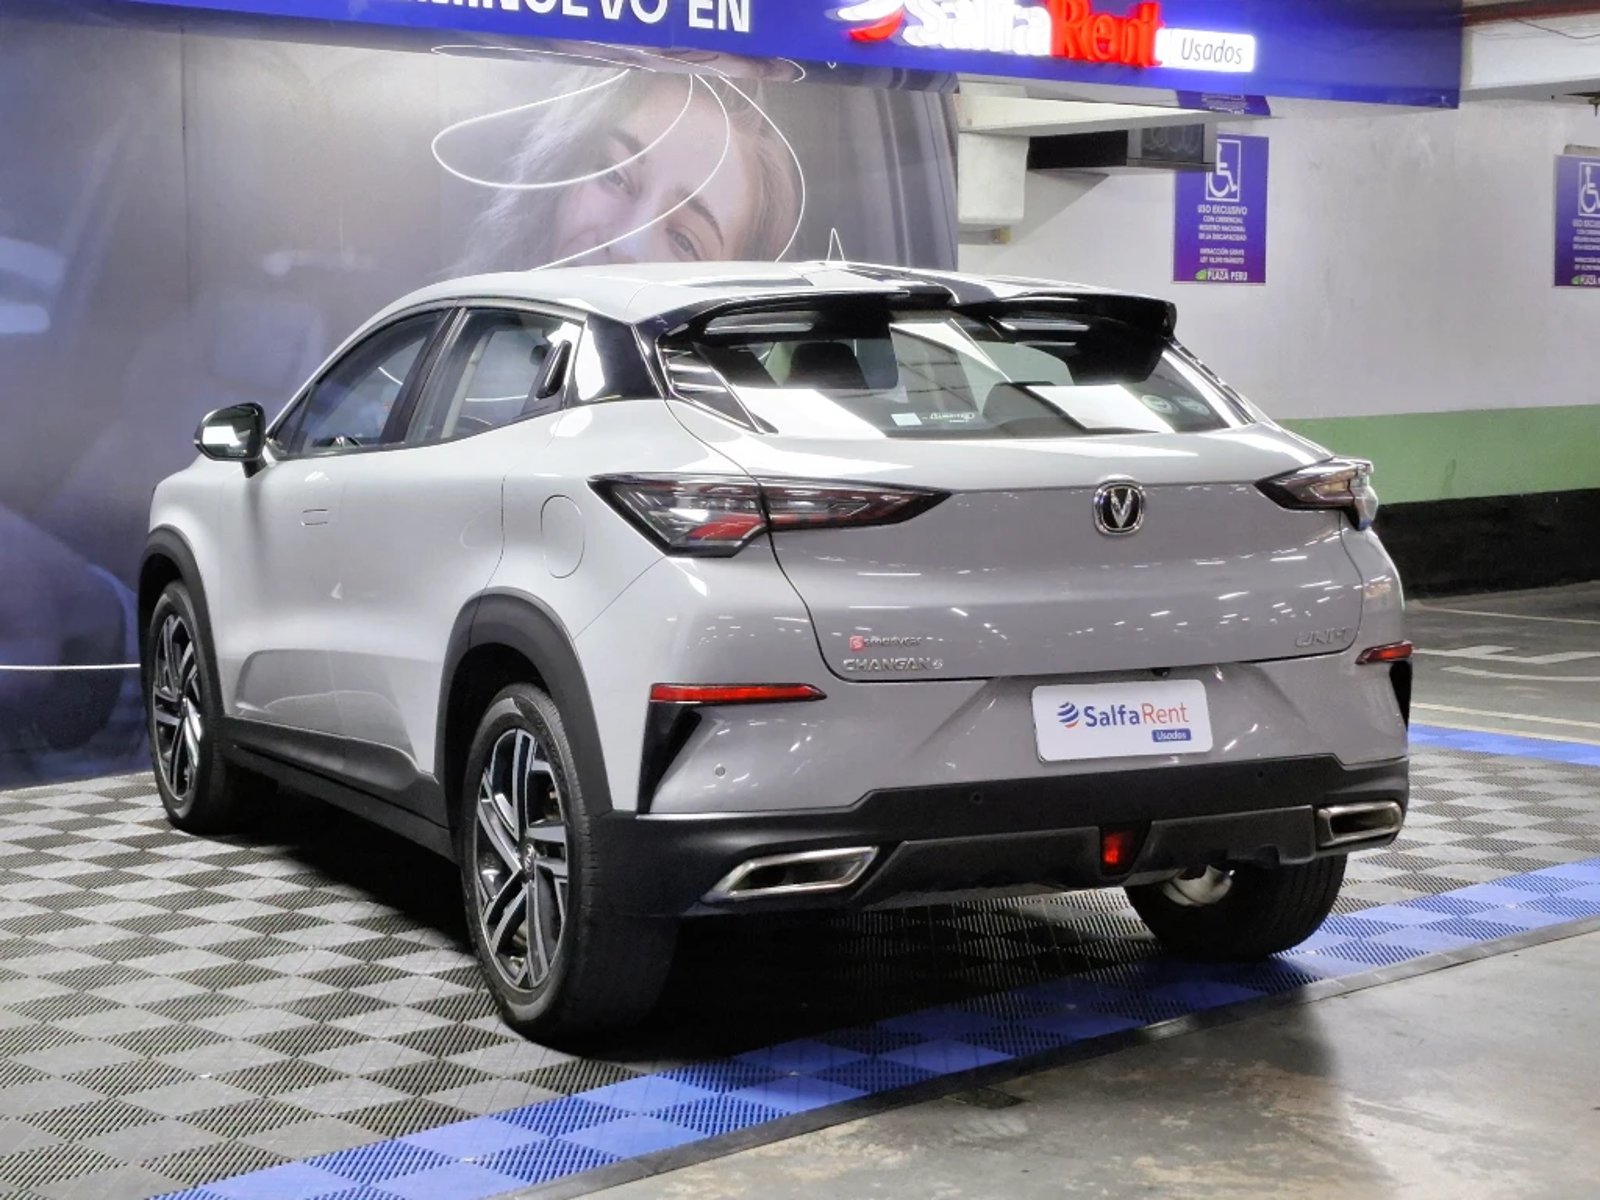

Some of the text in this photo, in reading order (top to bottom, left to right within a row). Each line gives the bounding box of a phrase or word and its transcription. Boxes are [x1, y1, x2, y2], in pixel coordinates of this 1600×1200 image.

[688, 0, 750, 33] EN
[1180, 36, 1243, 65] Usados
[1083, 702, 1190, 728] SalfaRent
[1156, 730, 1187, 741] Usados
